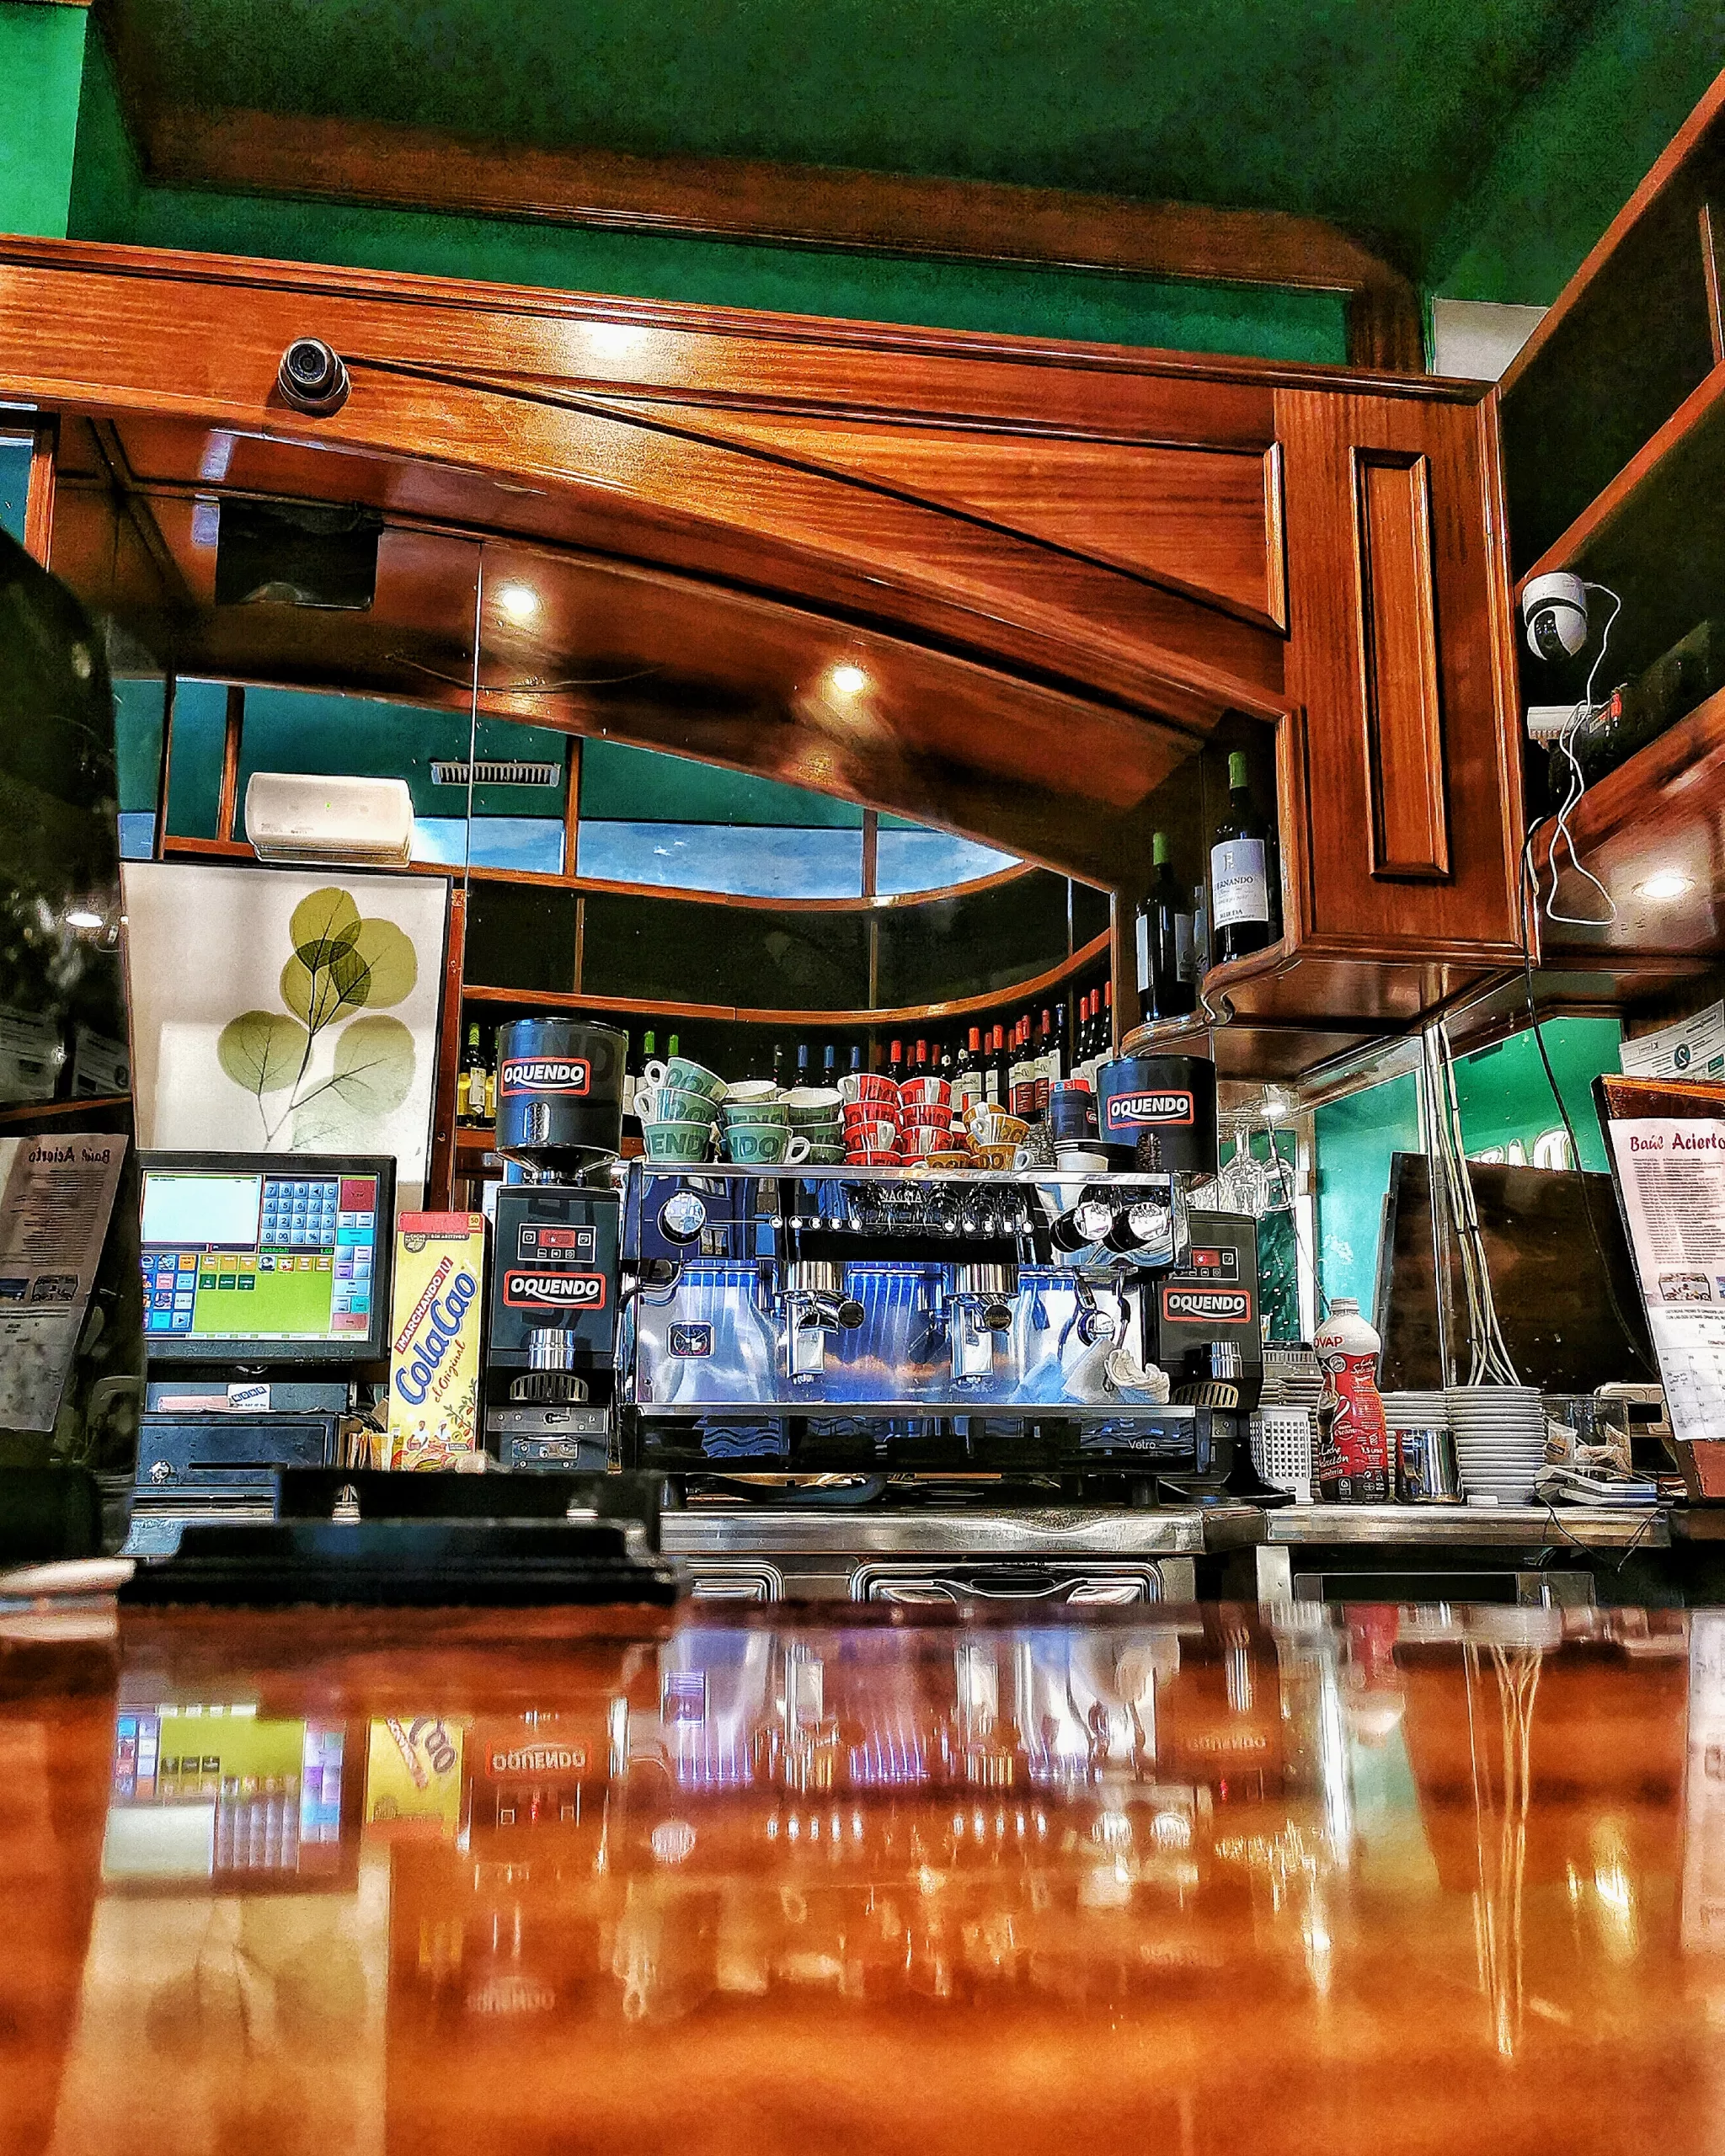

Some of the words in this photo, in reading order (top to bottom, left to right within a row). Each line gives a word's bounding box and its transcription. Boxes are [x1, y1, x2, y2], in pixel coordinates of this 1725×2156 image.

[504, 1064, 585, 1087] OQUENDO
[1111, 1097, 1188, 1119] OQUENDO
[1672, 1133, 1725, 1150] Acierto
[510, 1278, 600, 1301] OQUENDO
[1168, 1294, 1245, 1315] OQUENDO
[395, 1272, 478, 1406] ColaCao
[438, 1339, 467, 1390] Original
[1128, 1438, 1156, 1449] Vetro
